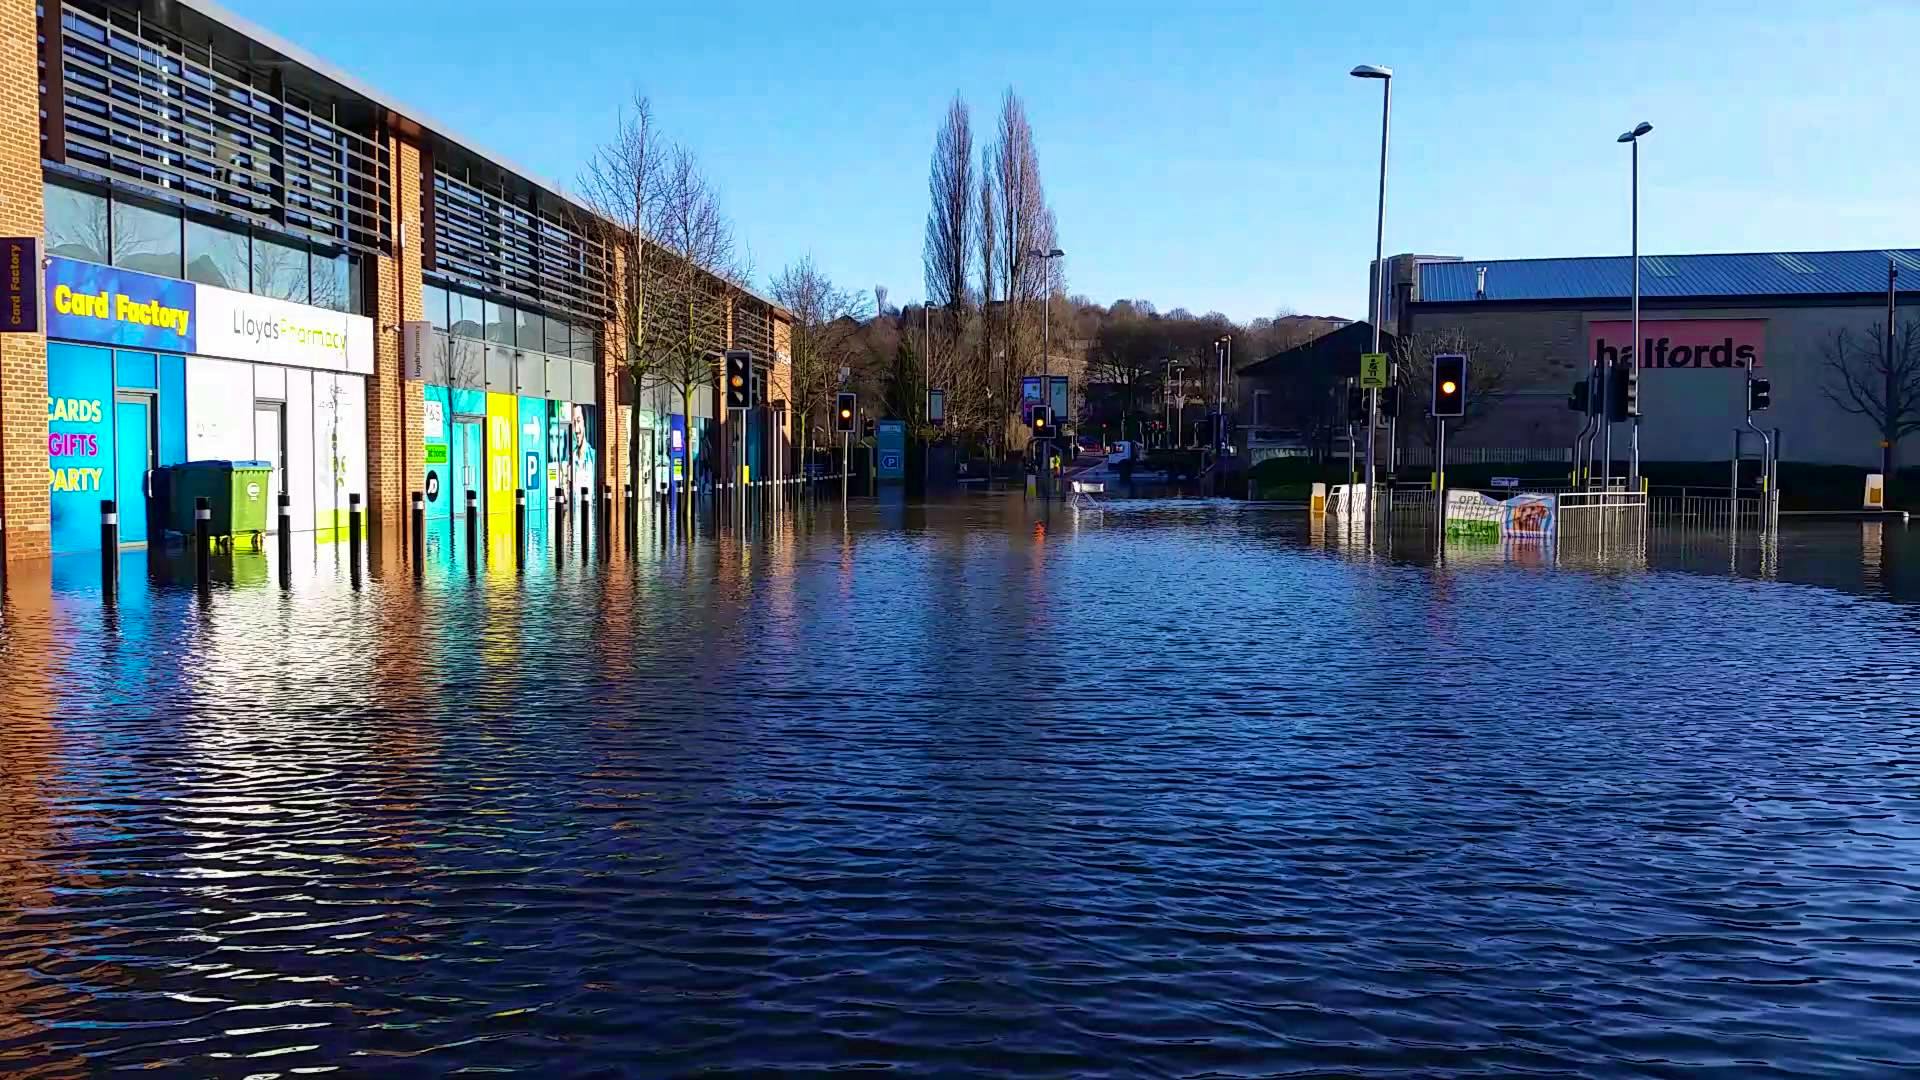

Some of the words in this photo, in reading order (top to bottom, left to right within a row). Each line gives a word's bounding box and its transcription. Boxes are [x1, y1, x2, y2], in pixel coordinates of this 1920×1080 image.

[10, 244, 24, 291] Factory
[10, 295, 22, 326] Card
[54, 283, 109, 319] Card
[115, 293, 190, 336] Factory
[1595, 337, 1757, 368] halfords
[48, 432, 98, 457] GIFTS
[527, 455, 538, 487] P
